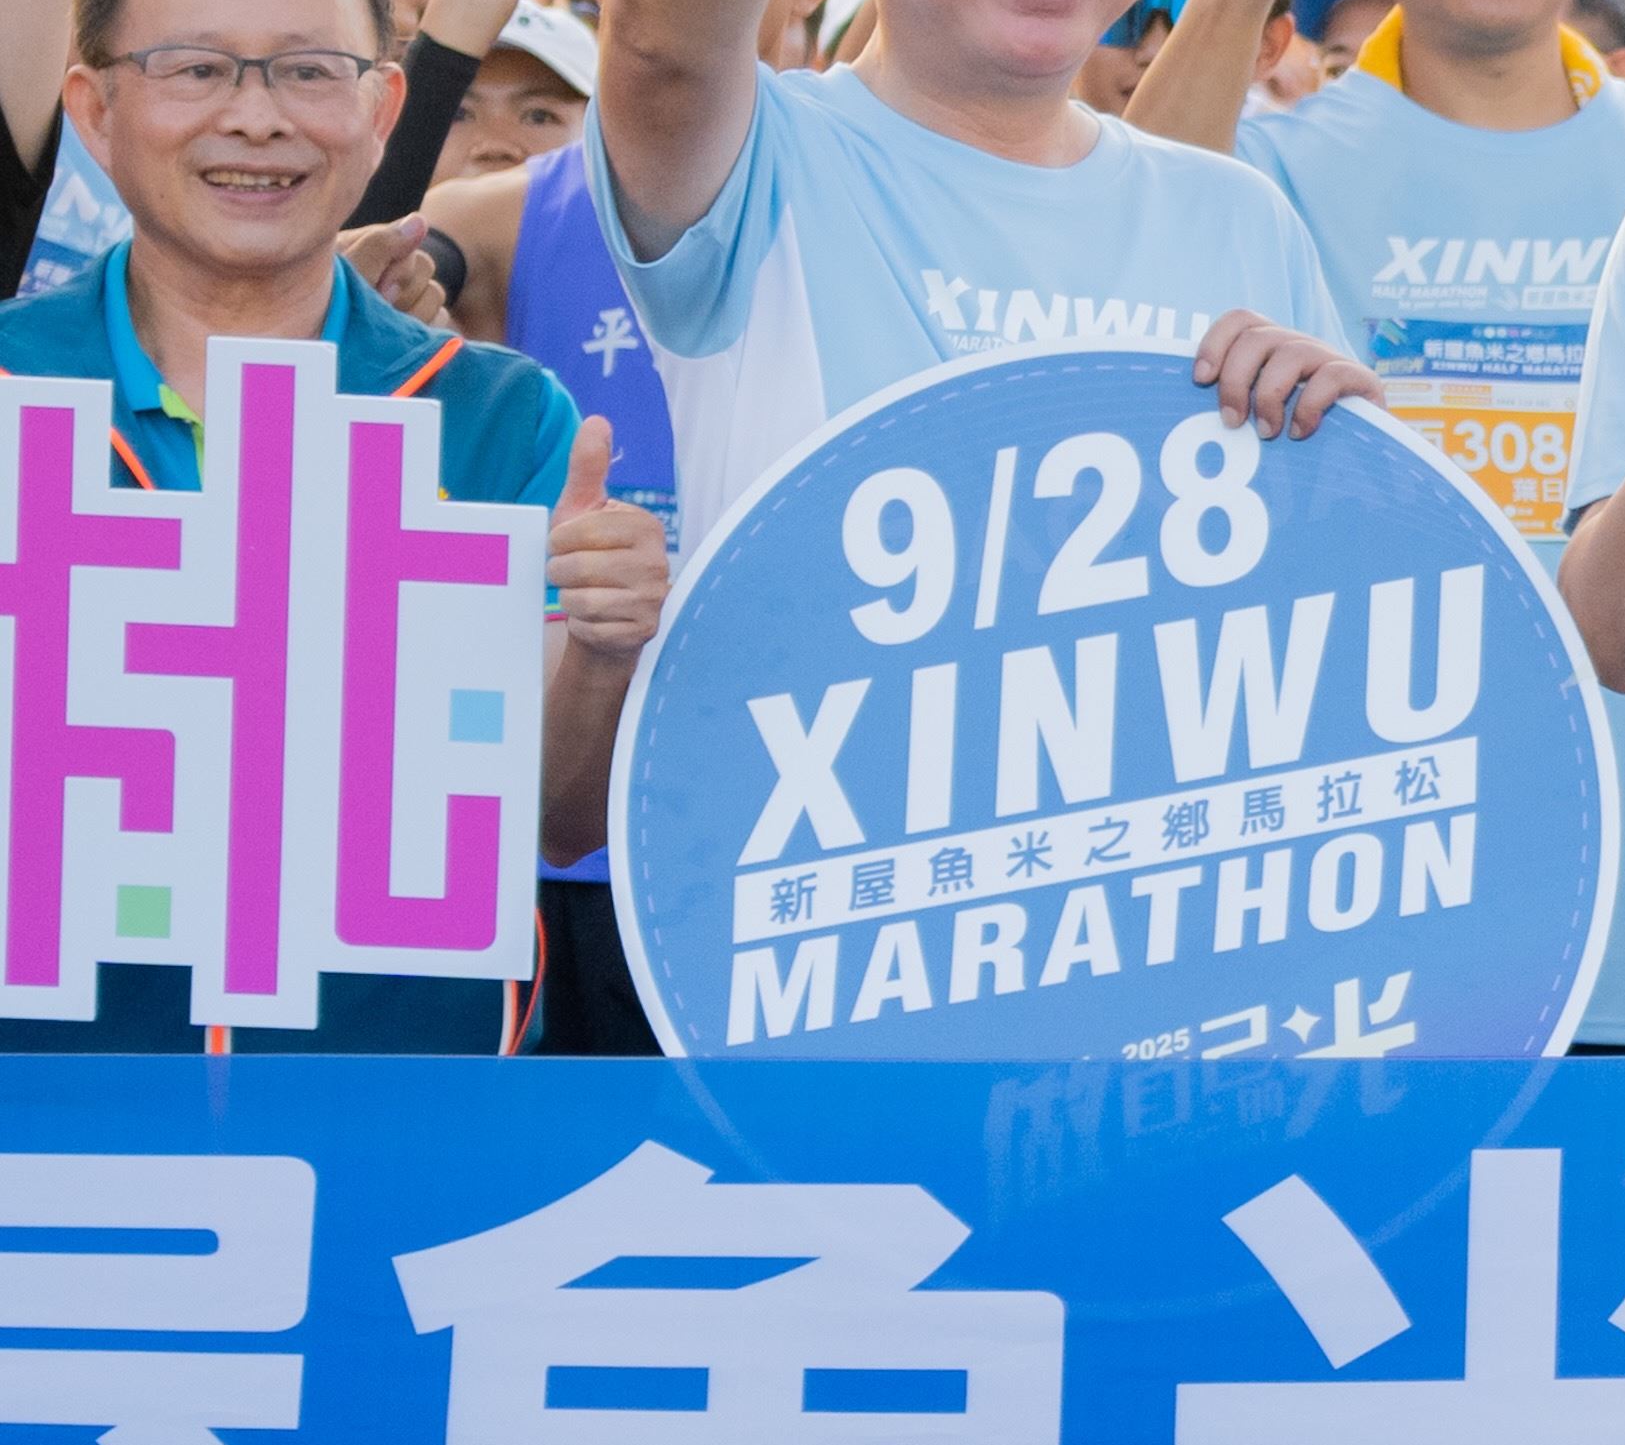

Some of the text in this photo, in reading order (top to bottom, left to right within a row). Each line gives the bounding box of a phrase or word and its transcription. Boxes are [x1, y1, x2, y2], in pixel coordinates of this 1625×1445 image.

[1373, 237, 1610, 285] XINW
[582, 307, 640, 379] 平
[1423, 338, 1588, 366] 新屋魚米之鄉馬拉
[842, 410, 1270, 646] 9/28
[737, 563, 1485, 867] XINWU
[769, 757, 1444, 925] 新屋魚米之鄉馬拉松
[726, 814, 1479, 1048] MARATHON
[1121, 1027, 1192, 1060] 2025
